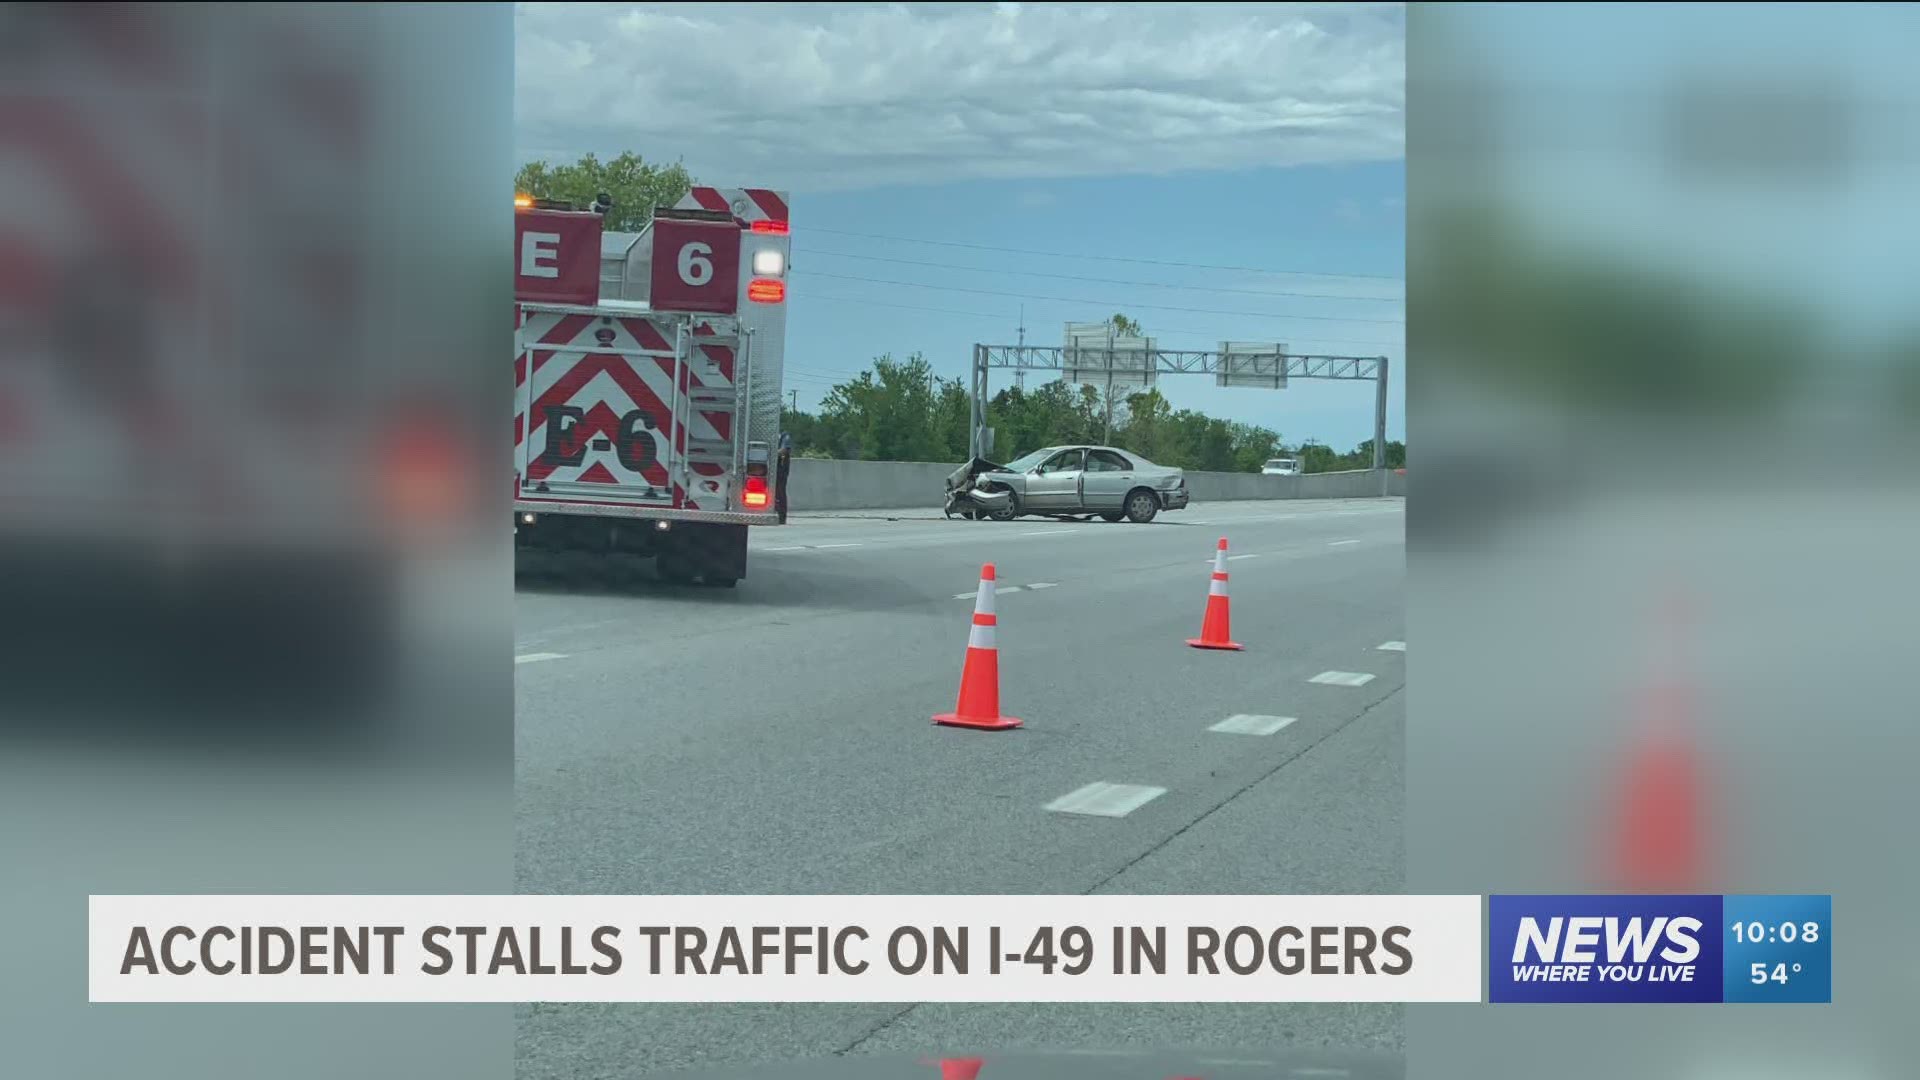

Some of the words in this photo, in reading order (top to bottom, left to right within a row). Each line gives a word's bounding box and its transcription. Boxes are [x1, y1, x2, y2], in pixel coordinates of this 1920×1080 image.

[520, 232, 561, 278] E
[677, 242, 714, 287] 6
[543, 405, 658, 472] E-6
